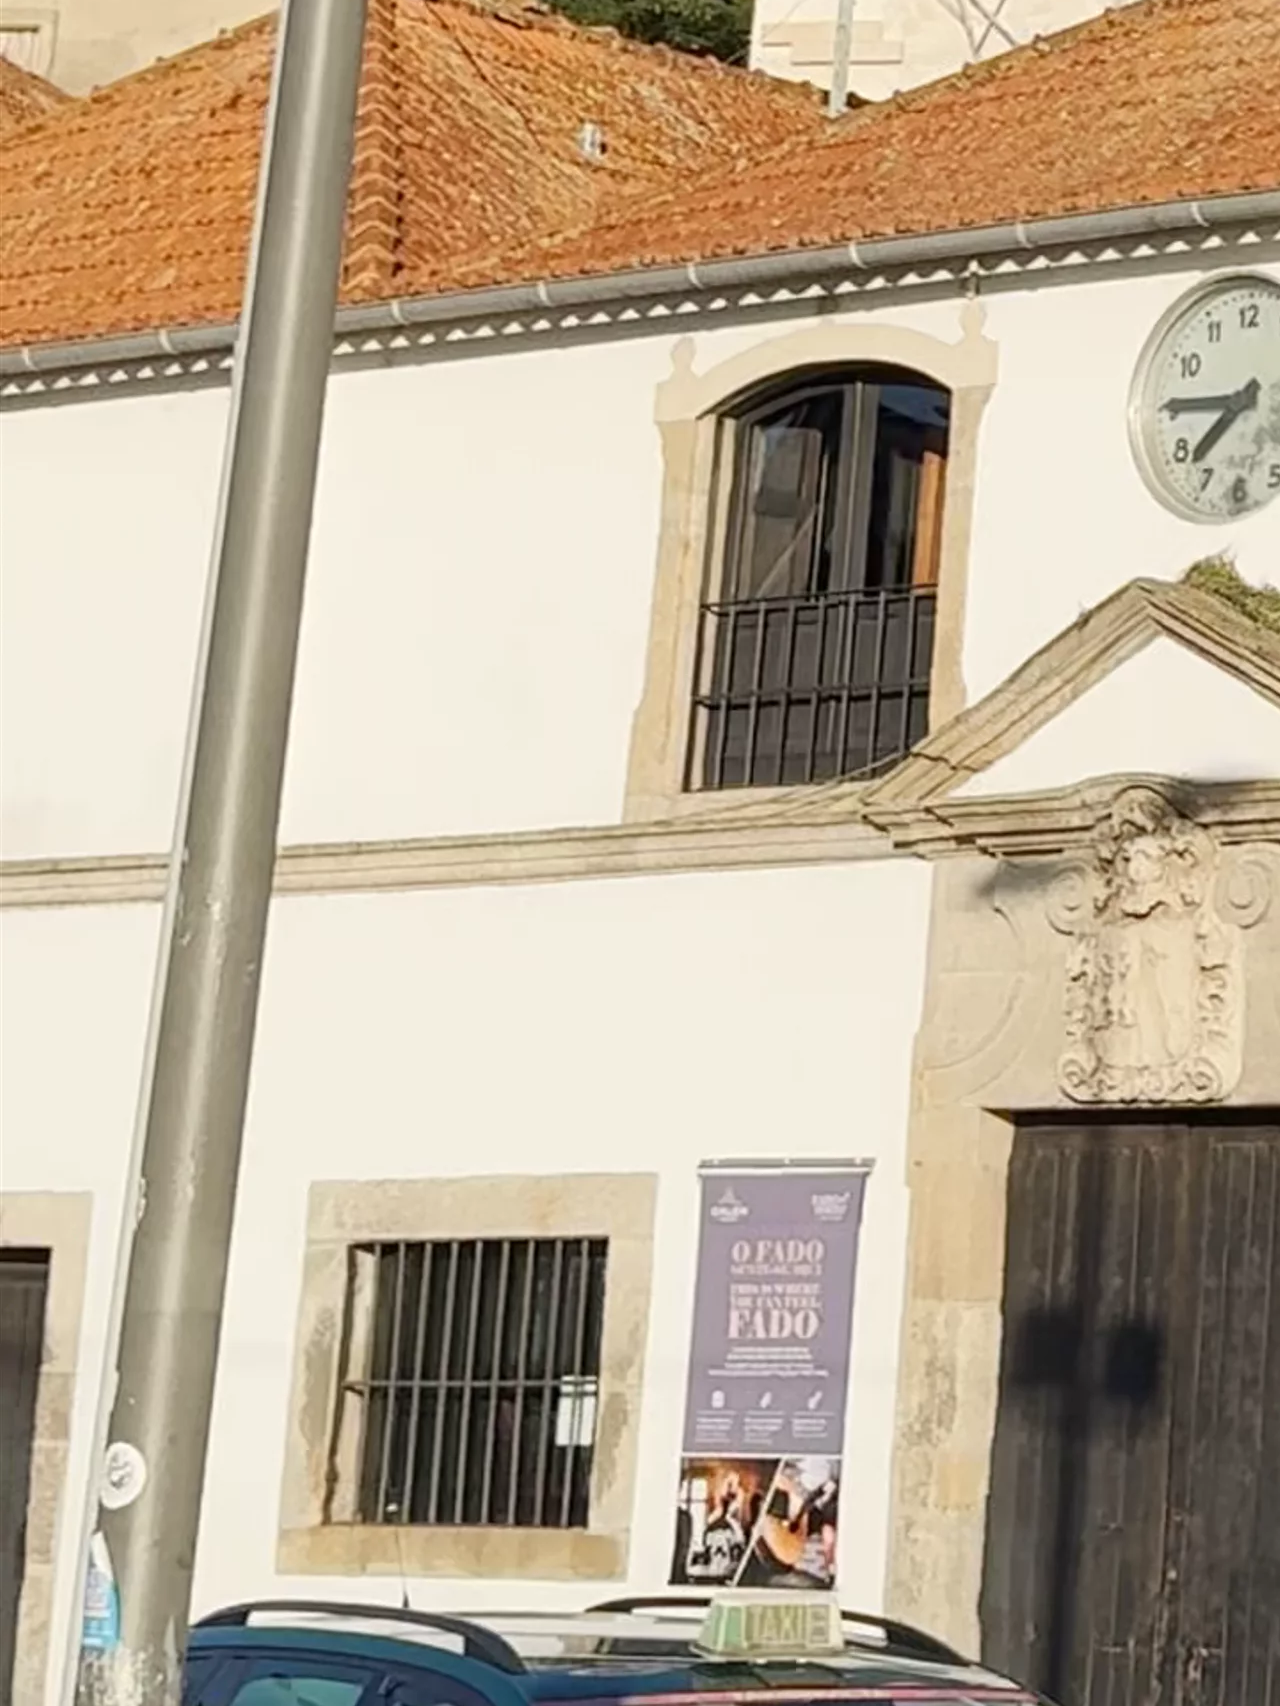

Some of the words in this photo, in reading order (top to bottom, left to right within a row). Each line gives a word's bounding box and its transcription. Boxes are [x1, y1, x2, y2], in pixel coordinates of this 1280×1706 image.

[1239, 304, 1260, 328] 12
[1207, 321, 1222, 343] 11
[1180, 352, 1202, 379] 10
[1173, 437, 1189, 463] 8
[1200, 468, 1214, 492] 7
[1232, 476, 1248, 503] 6
[731, 1240, 751, 1263] O
[755, 1239, 825, 1264] FADO
[728, 1309, 819, 1339] FADO
[750, 1605, 803, 1642] TAXI
